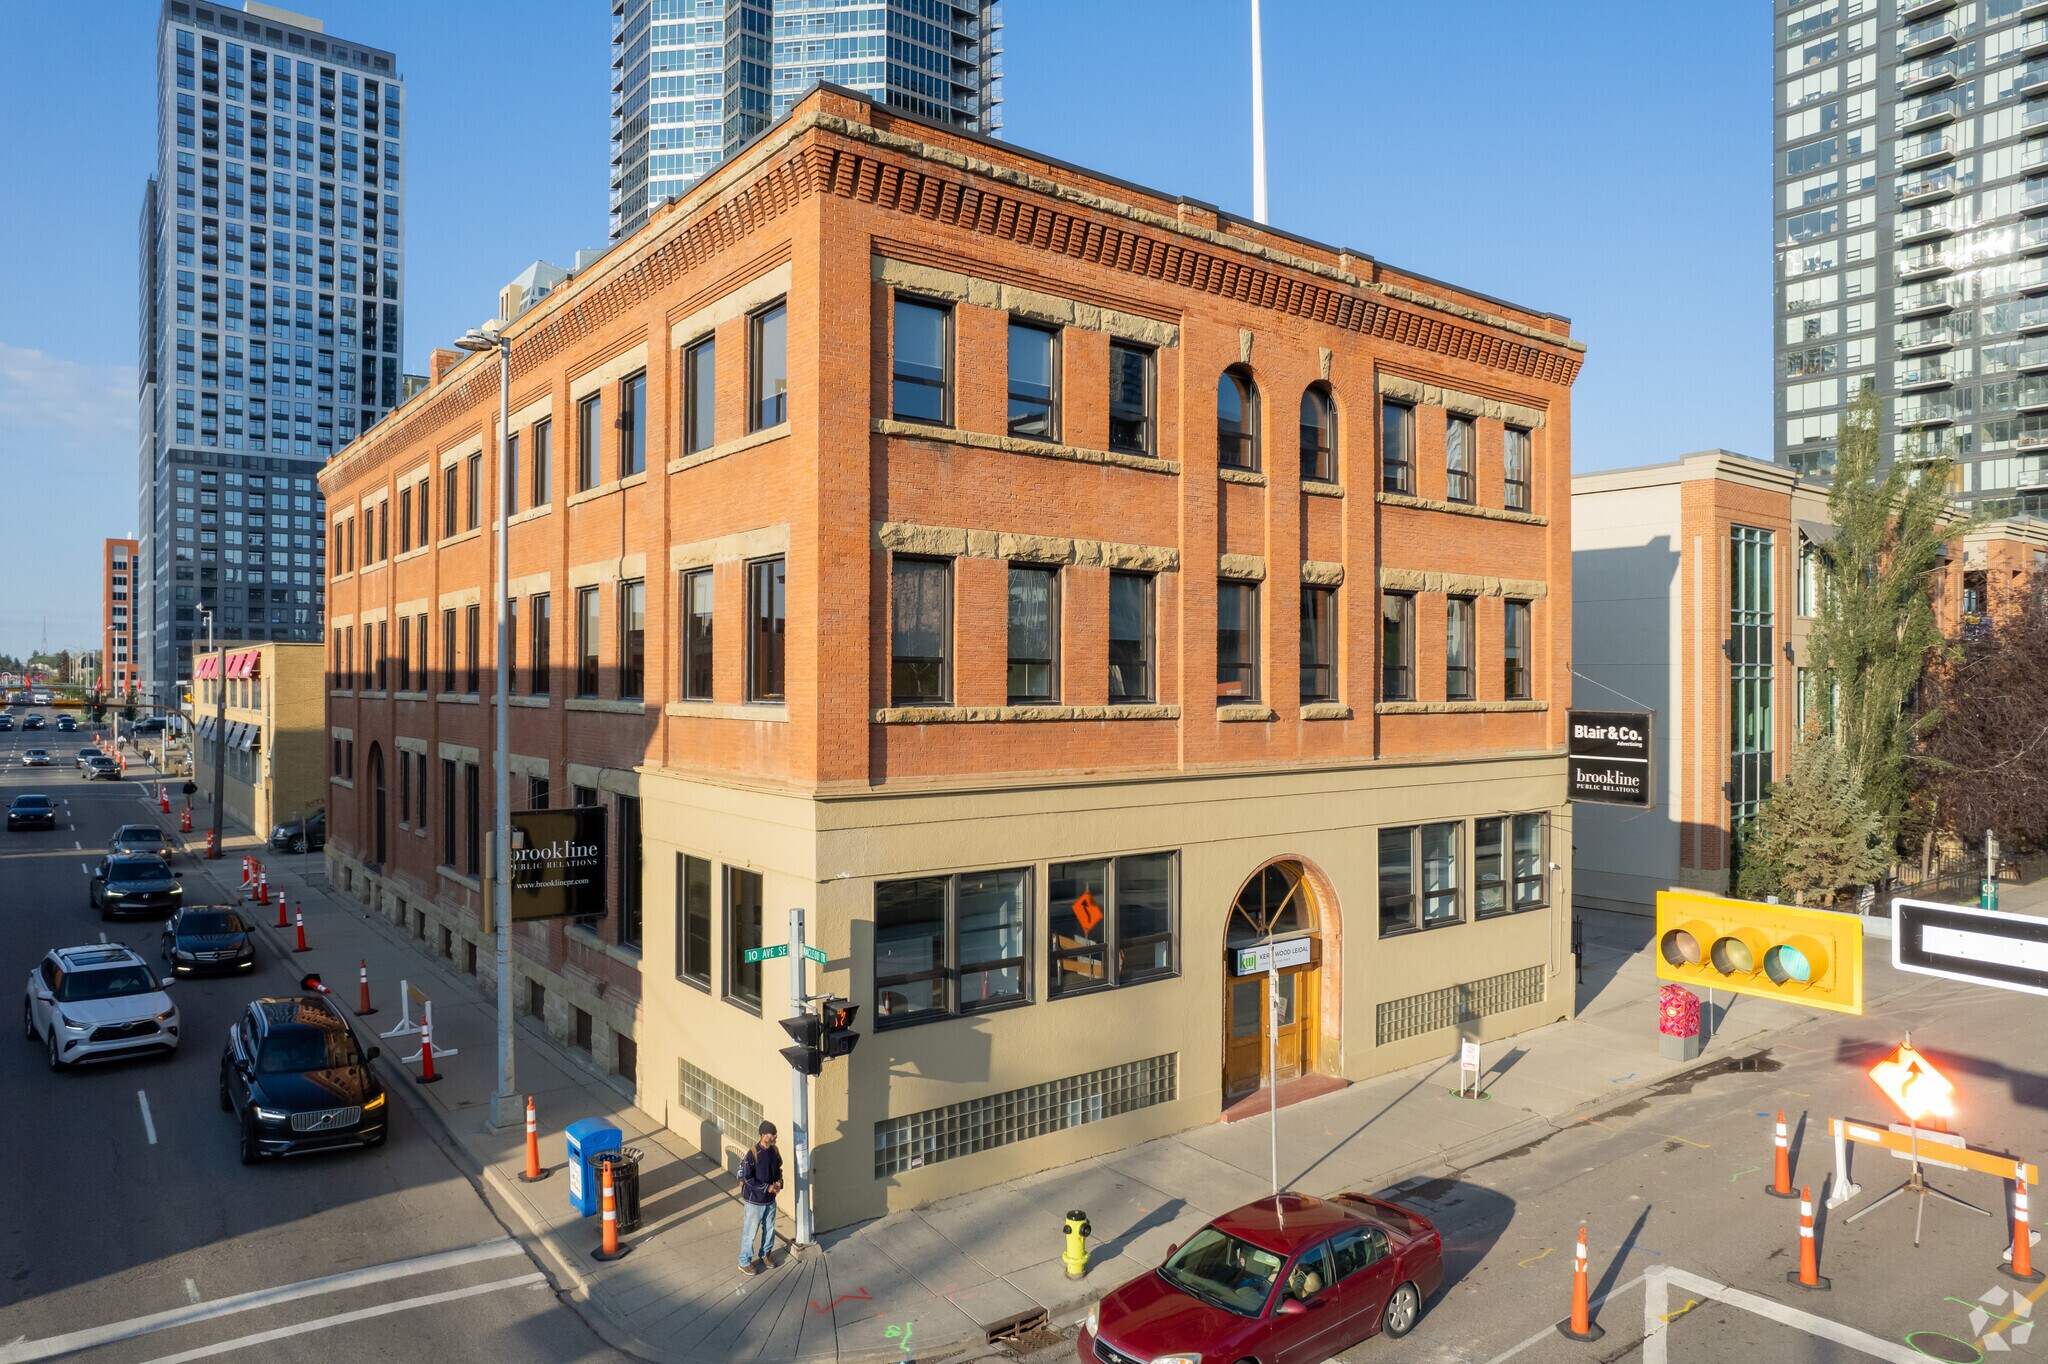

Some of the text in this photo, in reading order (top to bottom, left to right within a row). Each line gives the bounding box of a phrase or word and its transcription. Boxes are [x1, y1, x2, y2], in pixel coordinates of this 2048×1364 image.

[1574, 725, 1643, 741] Blair&Co.
[1616, 741, 1643, 749] Advertising
[1576, 768, 1640, 787] brookline
[1576, 783, 1640, 793] PUBLIC RELATIONS
[510, 859, 598, 871] UBLIC RELATIONS
[516, 878, 589, 889] www.brooklinepr.com
[748, 945, 787, 961] 10 AVE SE
[1274, 949, 1292, 958] WOOD
